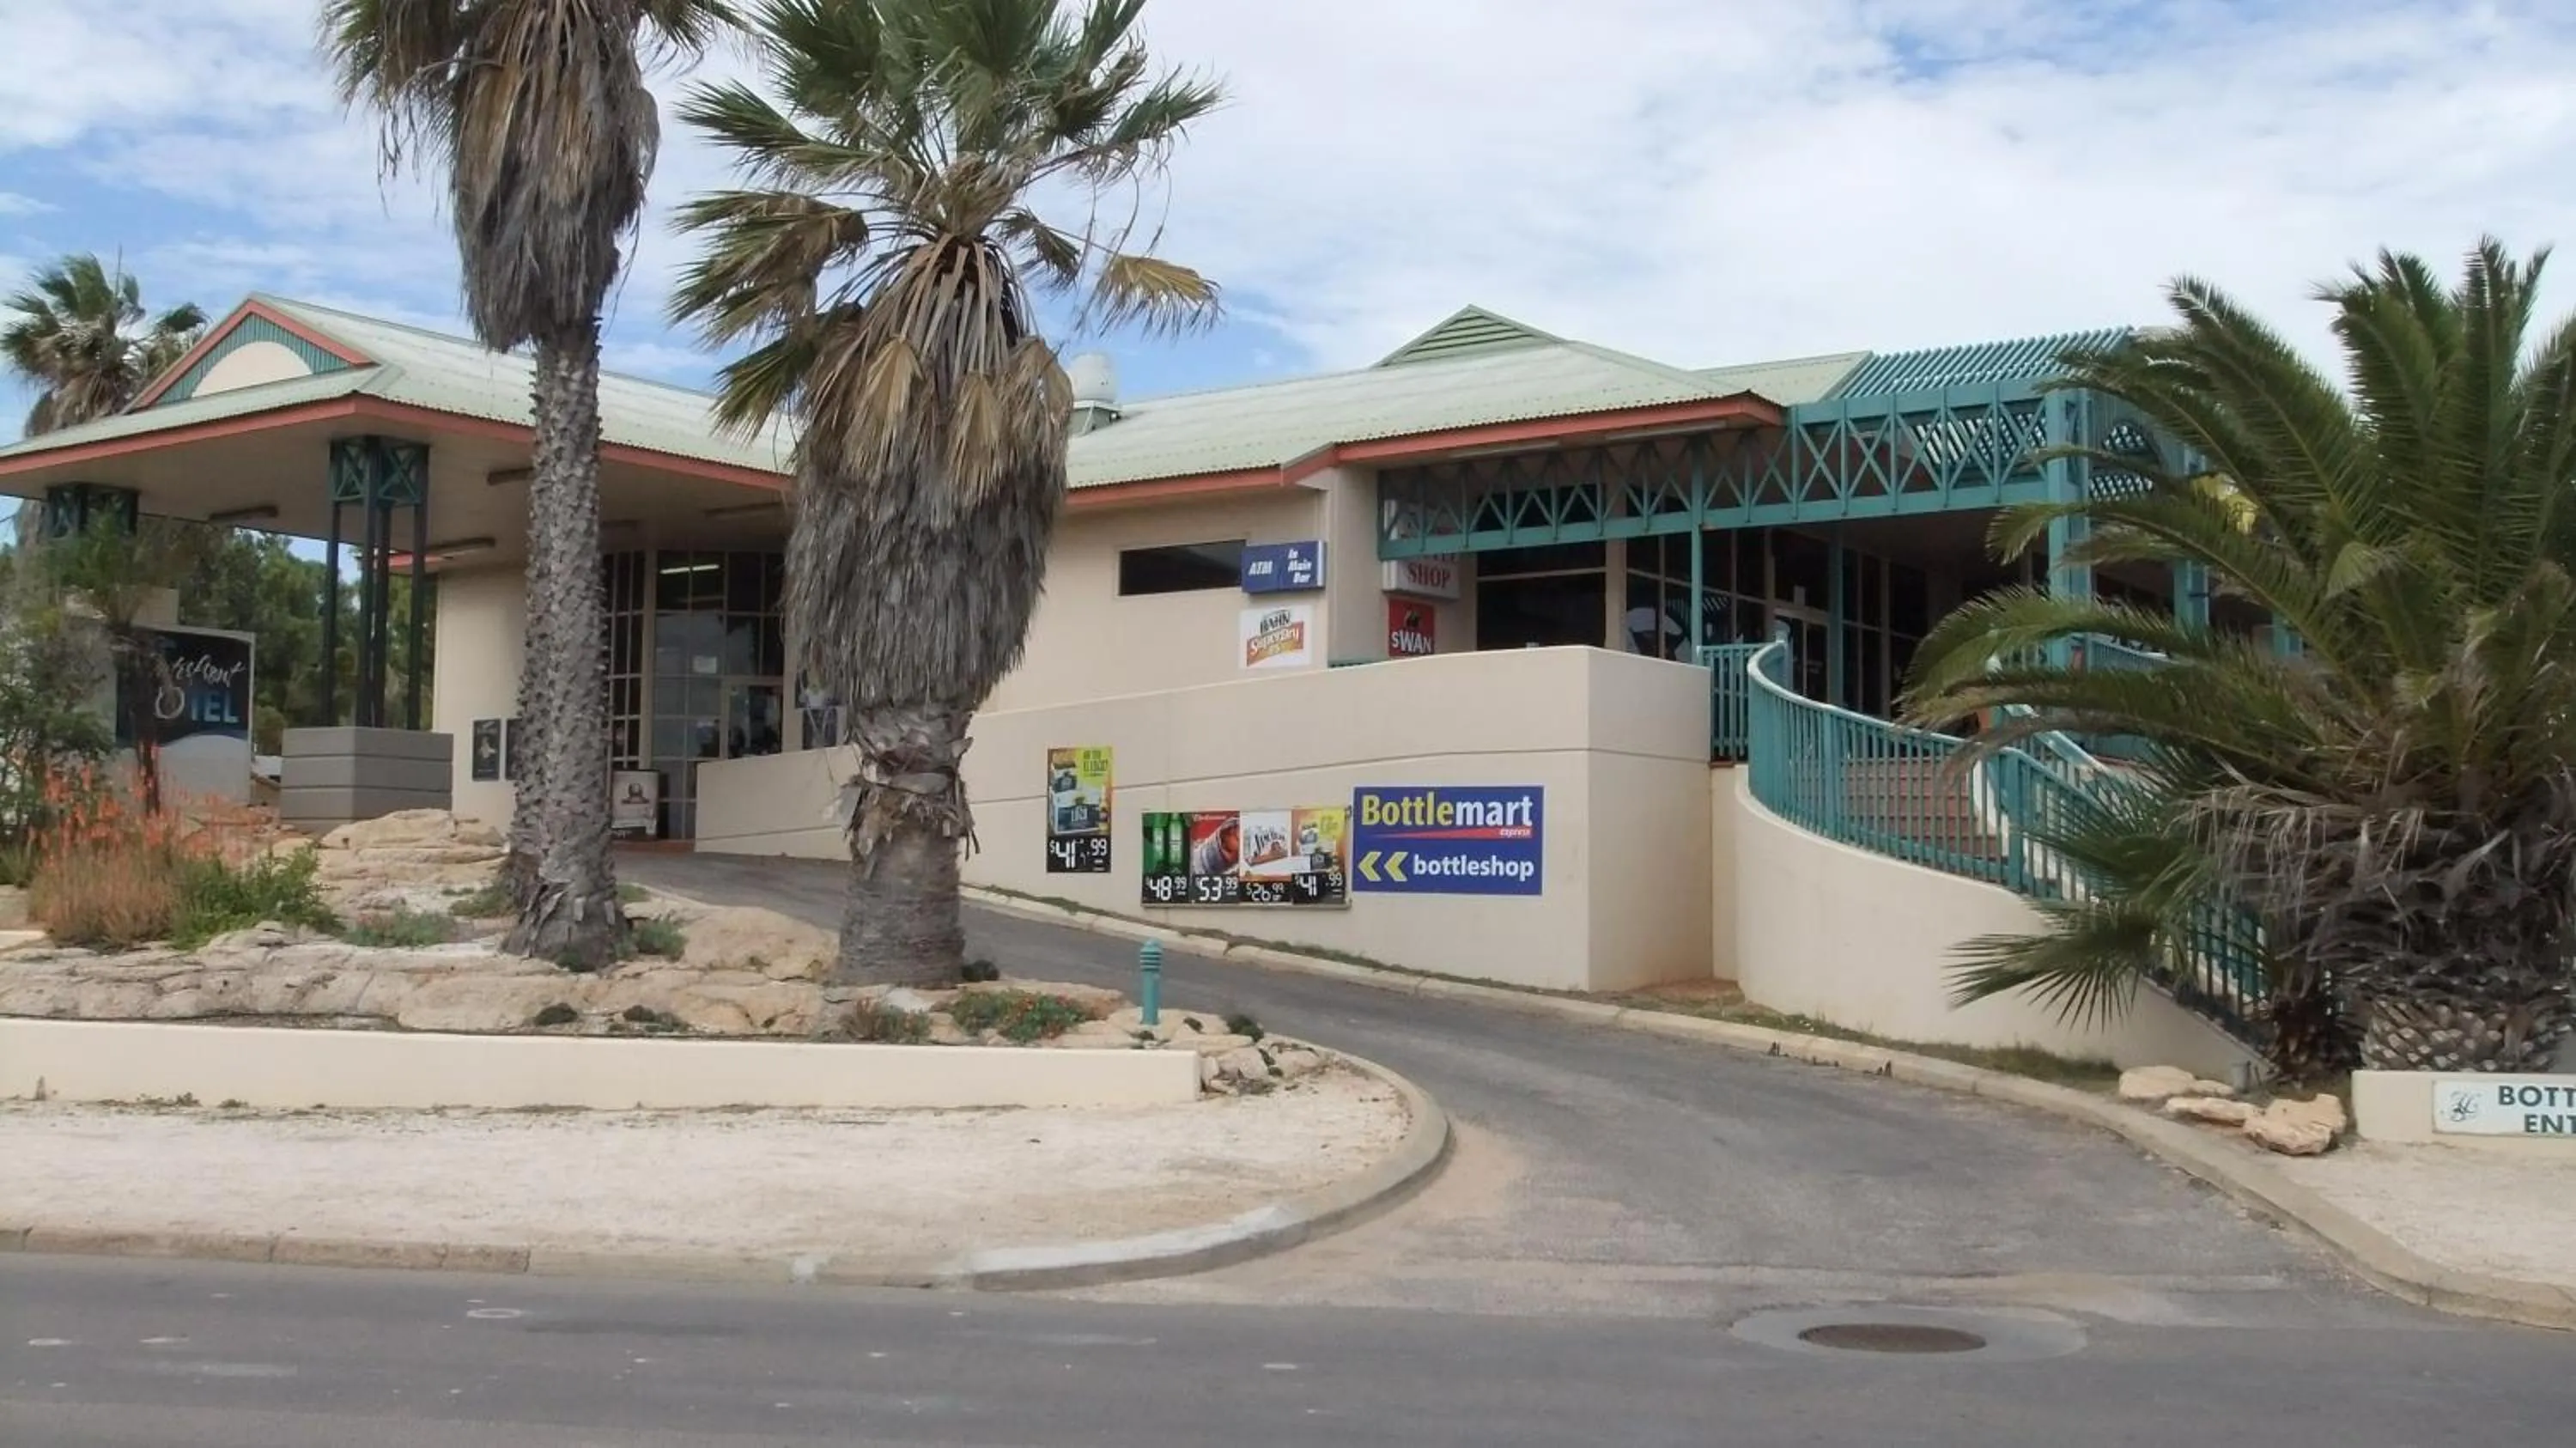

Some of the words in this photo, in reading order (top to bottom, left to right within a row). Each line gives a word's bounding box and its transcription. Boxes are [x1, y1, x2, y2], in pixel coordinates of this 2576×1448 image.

[1248, 560, 1273, 575] ATM
[1288, 559, 1312, 572] Main
[1407, 563, 1451, 589] SHOP
[1293, 572, 1311, 584] Bar
[1391, 629, 1432, 654] SWAN
[1360, 791, 1534, 826] Bottlemart
[1413, 854, 1534, 882] bottleshop
[2498, 1085, 2576, 1108] BOTT
